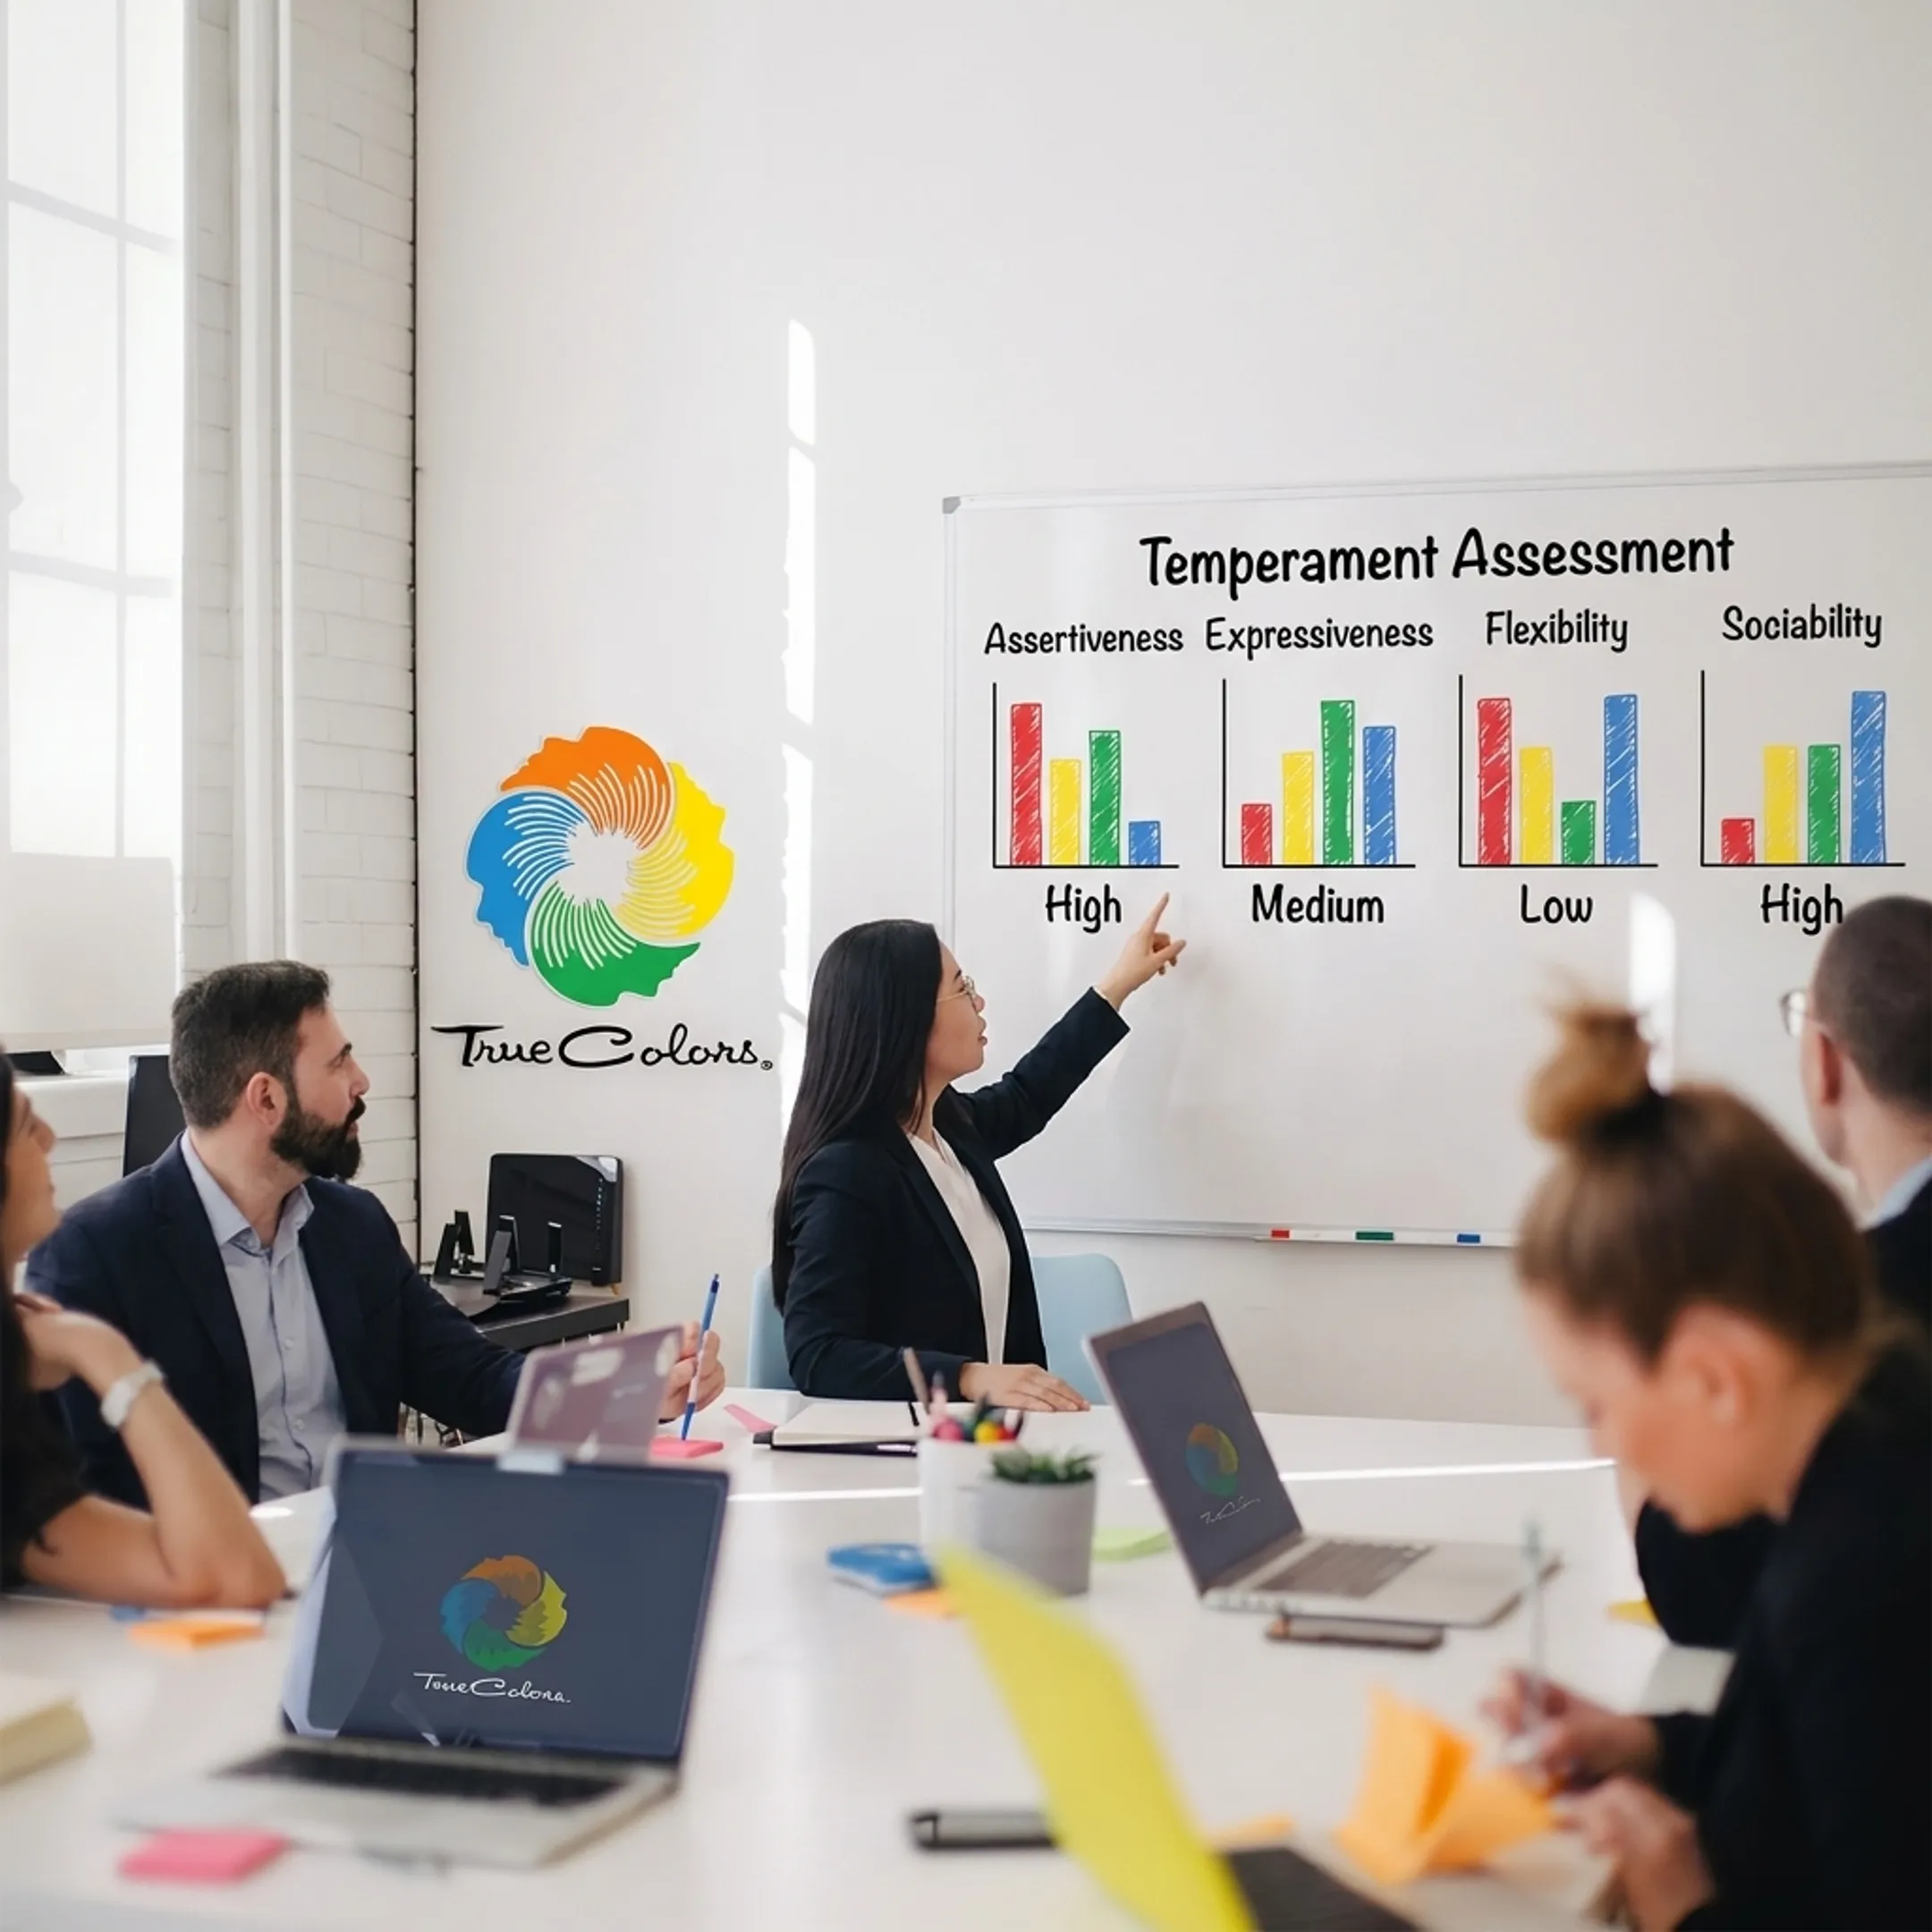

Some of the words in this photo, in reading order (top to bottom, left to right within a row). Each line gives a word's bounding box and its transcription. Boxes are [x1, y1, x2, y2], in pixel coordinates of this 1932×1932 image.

[1139, 535, 1439, 601] Temperament
[1452, 527, 1735, 579] Assessment
[984, 622, 1184, 655] Assertiveness
[1206, 616, 1434, 661] Expressiveness
[1486, 608, 1628, 653] Flexibility
[1722, 603, 1882, 648] Sociability
[1045, 883, 1122, 934] High
[1252, 883, 1385, 924] Medium
[1521, 884, 1593, 924] Low
[1760, 882, 1843, 936] High
[430, 1024, 554, 1068] True
